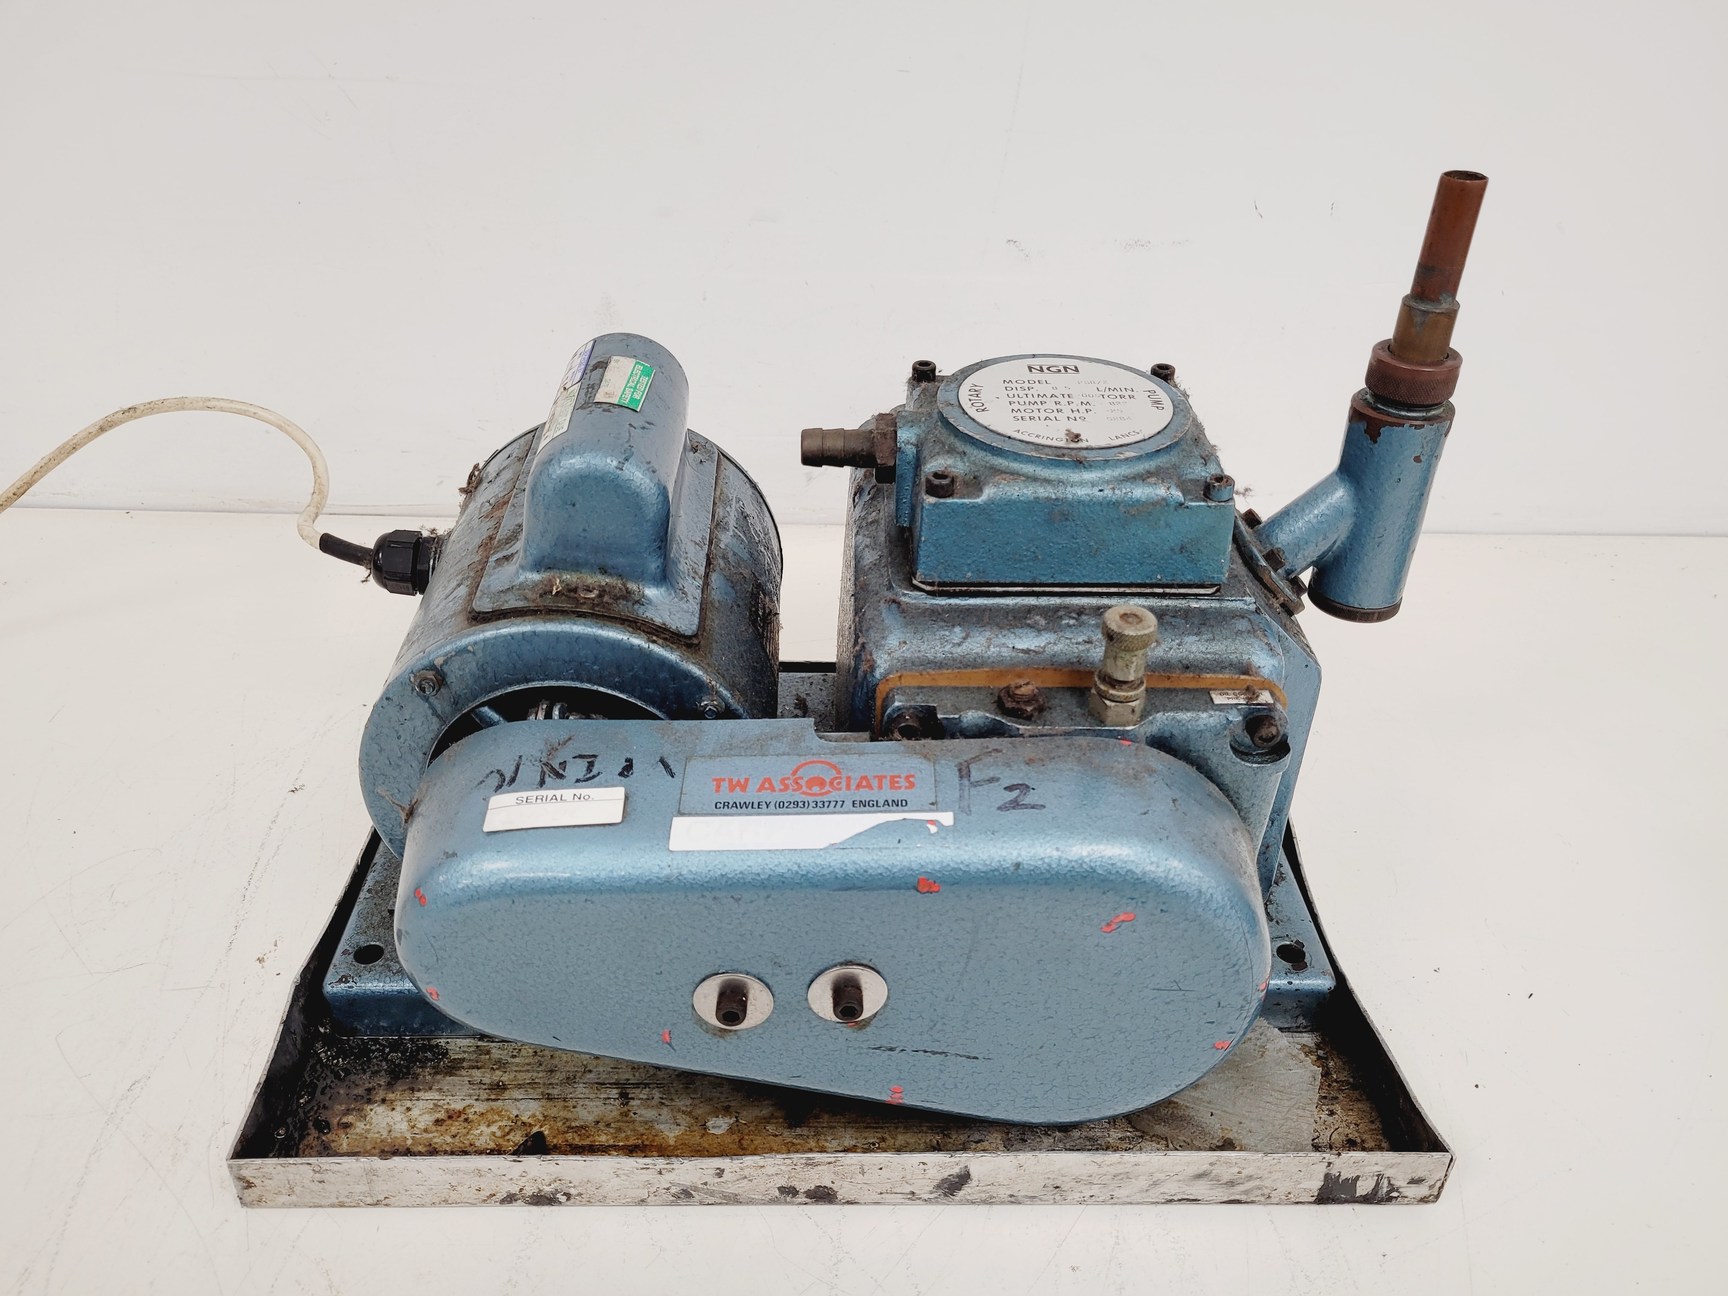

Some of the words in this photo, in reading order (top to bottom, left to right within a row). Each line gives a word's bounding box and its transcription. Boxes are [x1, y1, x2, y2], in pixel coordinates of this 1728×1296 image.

[1028, 365, 1080, 373] NGN
[968, 383, 989, 413] ROTARY
[1142, 389, 1165, 411] PUMP
[712, 777, 750, 794] TW
[756, 774, 916, 794] ASSOCIATES
[515, 793, 568, 805] SERIAL
[572, 792, 595, 801] No.
[714, 801, 771, 810] CRAWLEY
[852, 799, 908, 808] ENGLAND
